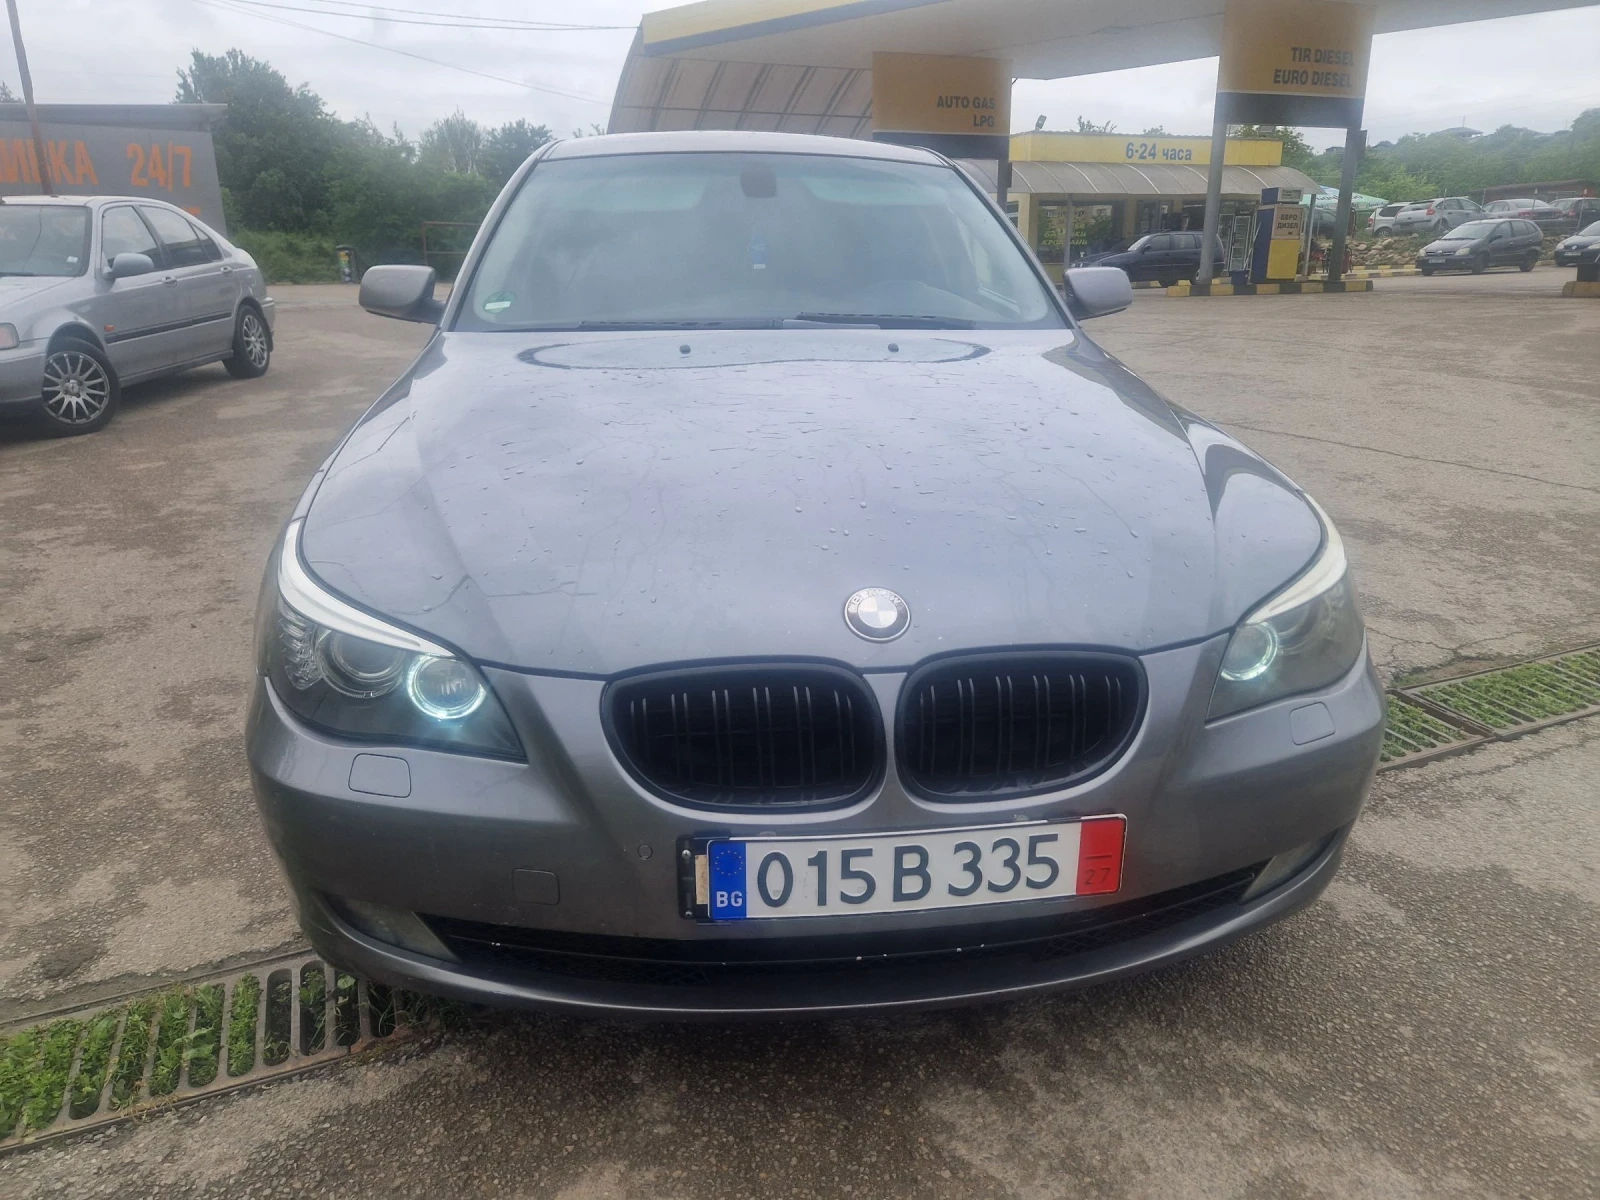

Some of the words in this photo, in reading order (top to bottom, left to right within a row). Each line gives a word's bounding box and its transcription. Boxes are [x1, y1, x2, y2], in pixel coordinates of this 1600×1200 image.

[1291, 47, 1311, 62] TIR
[1314, 48, 1353, 66] DIESEL
[1273, 69, 1308, 85] EURO
[1312, 71, 1352, 87] DIESEL
[937, 95, 969, 108] AUTO
[972, 96, 995, 109] GAS
[973, 114, 995, 127] LPG
[1126, 142, 1157, 160] 6-24
[1162, 148, 1192, 160] часа
[127, 141, 192, 192] 24/7
[1084, 866, 1111, 886] 27
[716, 891, 743, 908] BG
